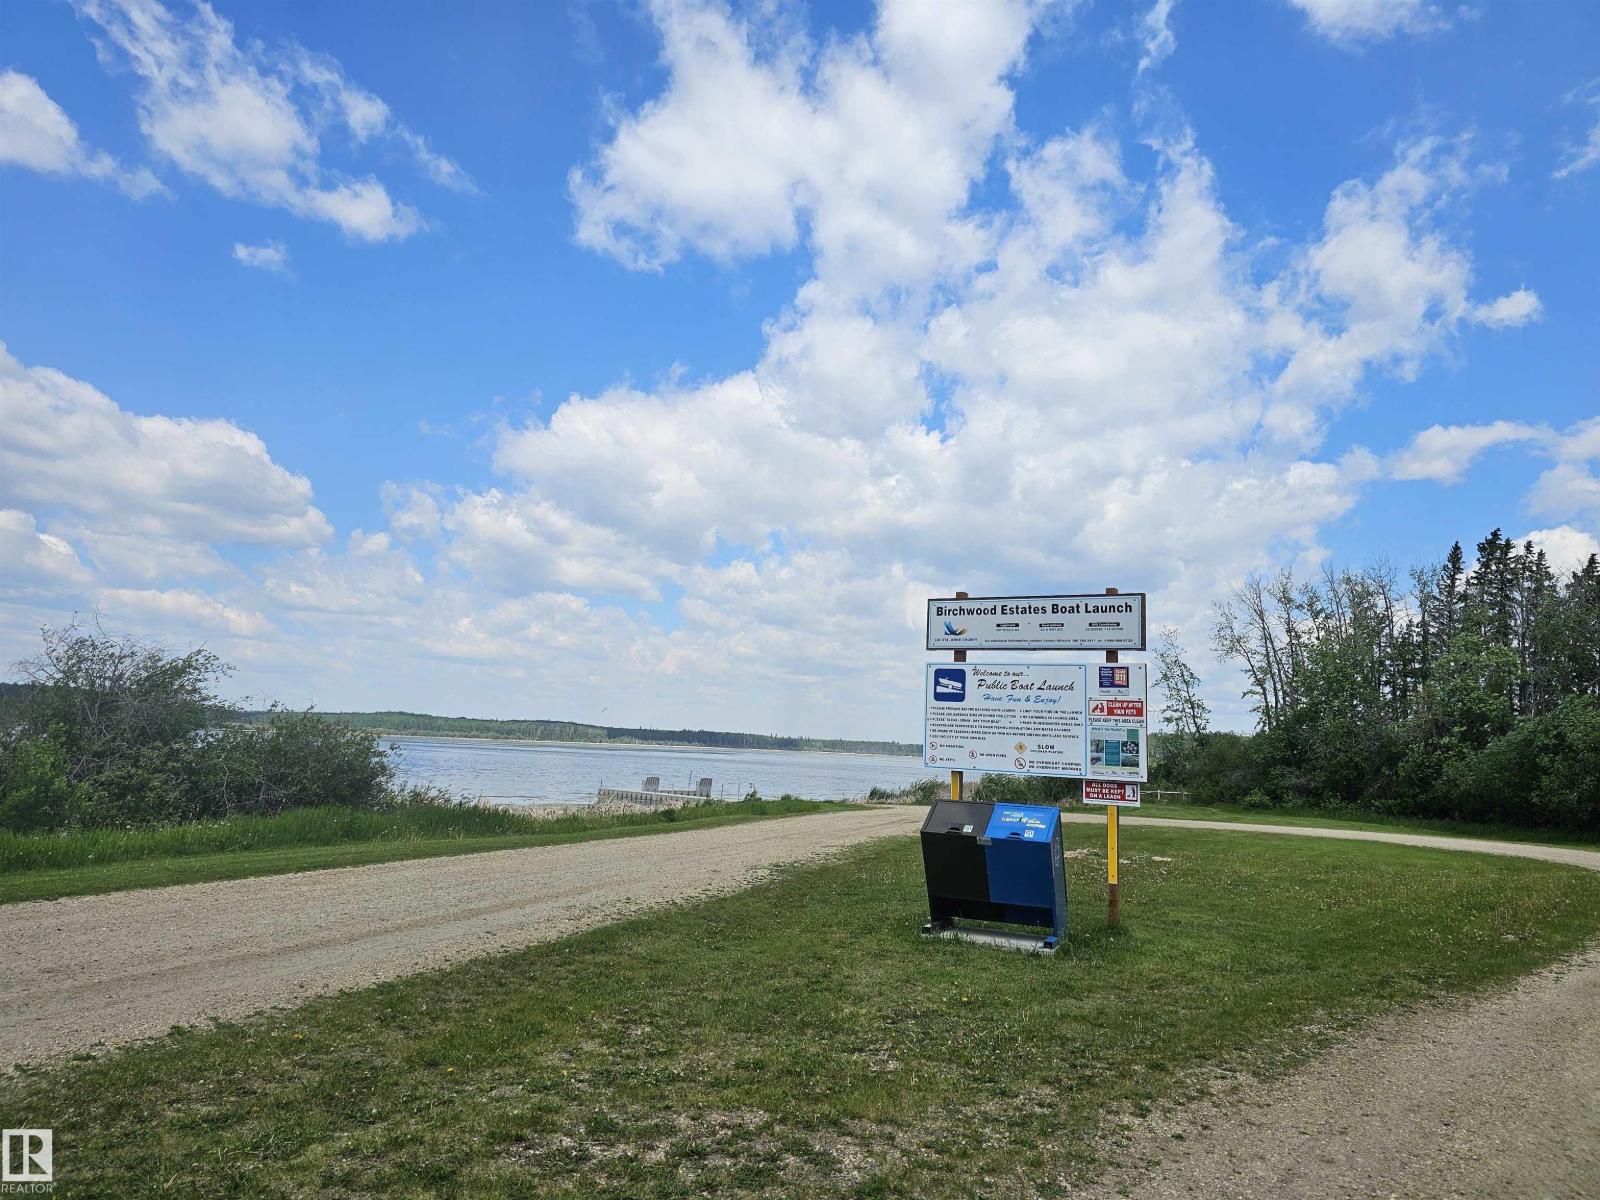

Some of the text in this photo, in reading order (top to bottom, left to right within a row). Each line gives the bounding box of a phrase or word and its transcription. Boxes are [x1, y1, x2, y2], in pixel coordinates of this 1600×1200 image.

[936, 602, 1132, 616] Birchwood Estates Boat Launch
[972, 668, 1002, 676] Welcome
[977, 678, 1074, 691] Public Boat Launch
[982, 694, 1002, 702] Have
[1006, 694, 1021, 702] Fun
[1034, 695, 1062, 704] Enjoy!
